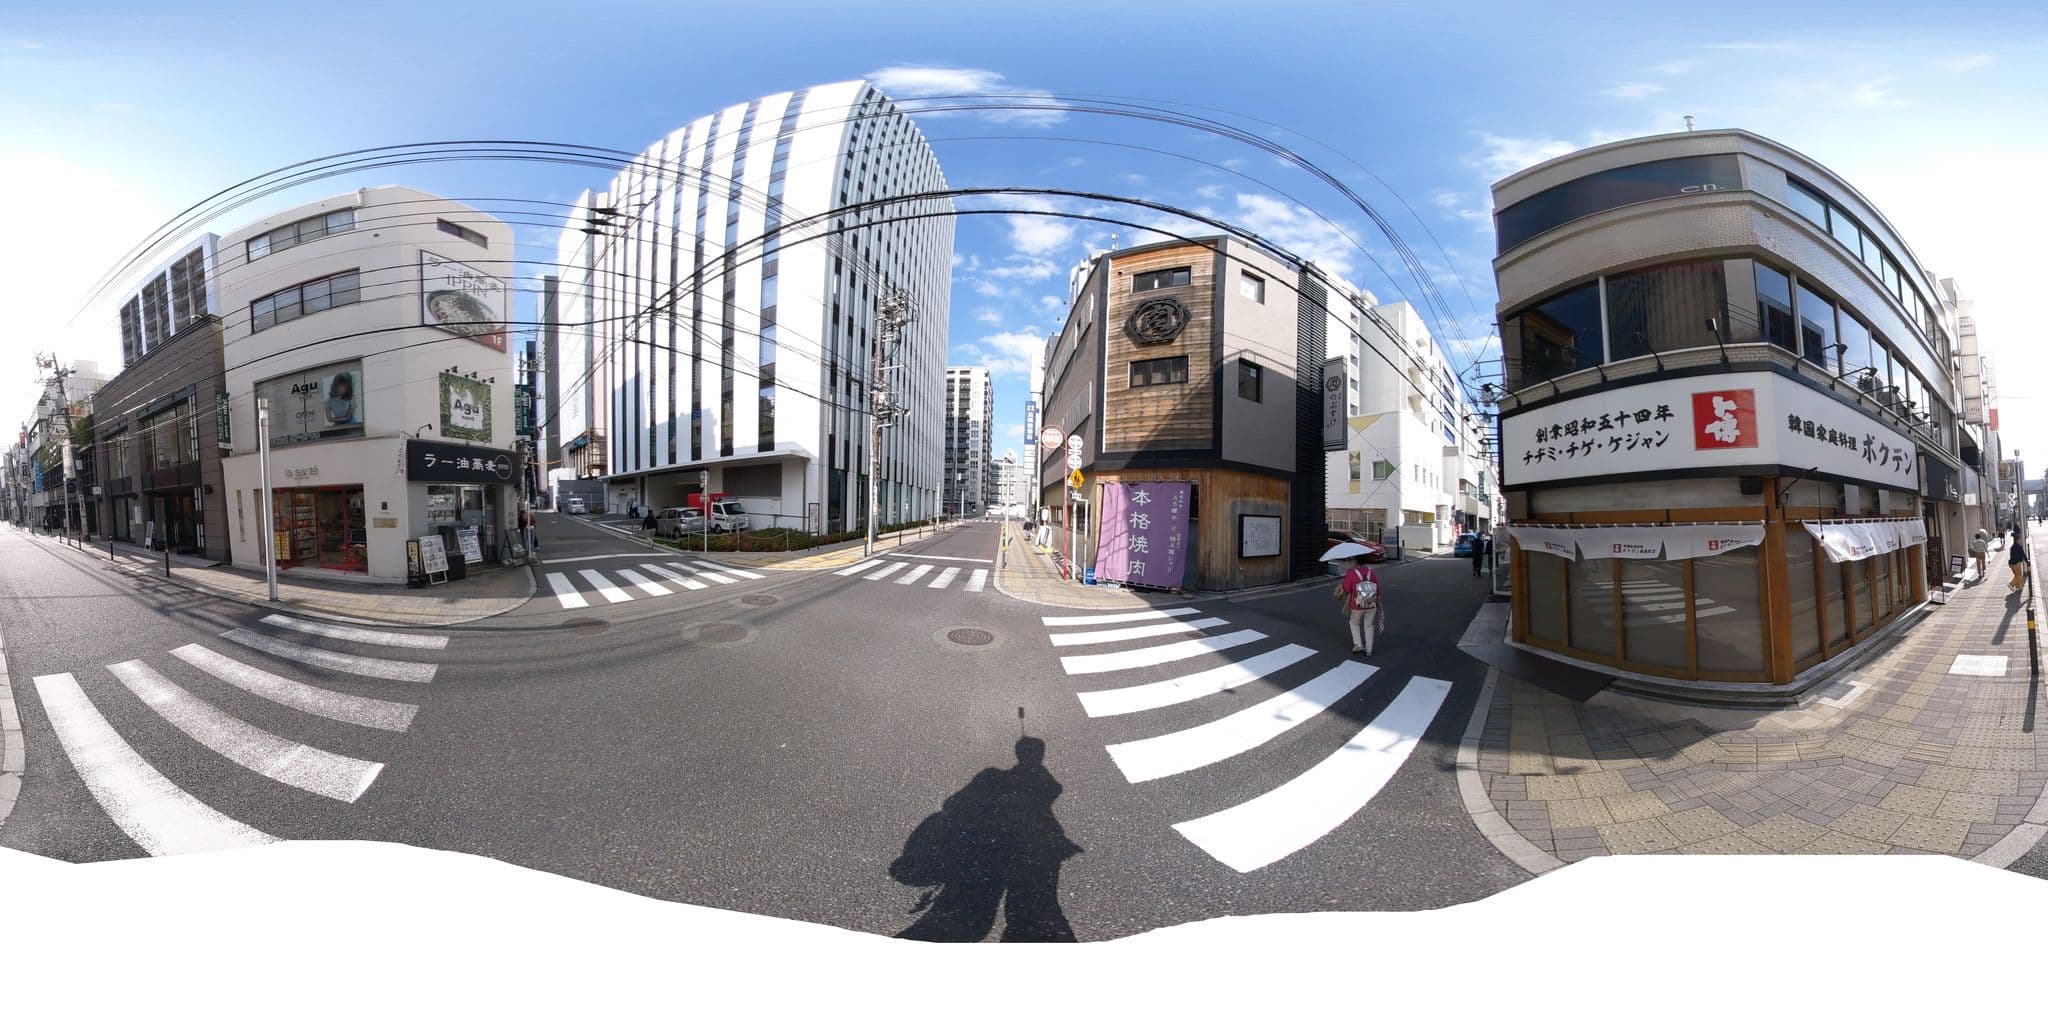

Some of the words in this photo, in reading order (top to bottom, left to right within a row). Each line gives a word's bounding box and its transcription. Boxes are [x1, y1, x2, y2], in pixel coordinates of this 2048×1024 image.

[492, 335, 503, 346] 1F
[291, 382, 318, 395] Agu
[454, 399, 480, 415] Agu
[1535, 404, 1675, 444] 創業昭和五十四年
[424, 453, 497, 472] ラー油蕎麦
[1862, 433, 1913, 476] ボクテン
[1127, 489, 1151, 577] 本格焼肉
